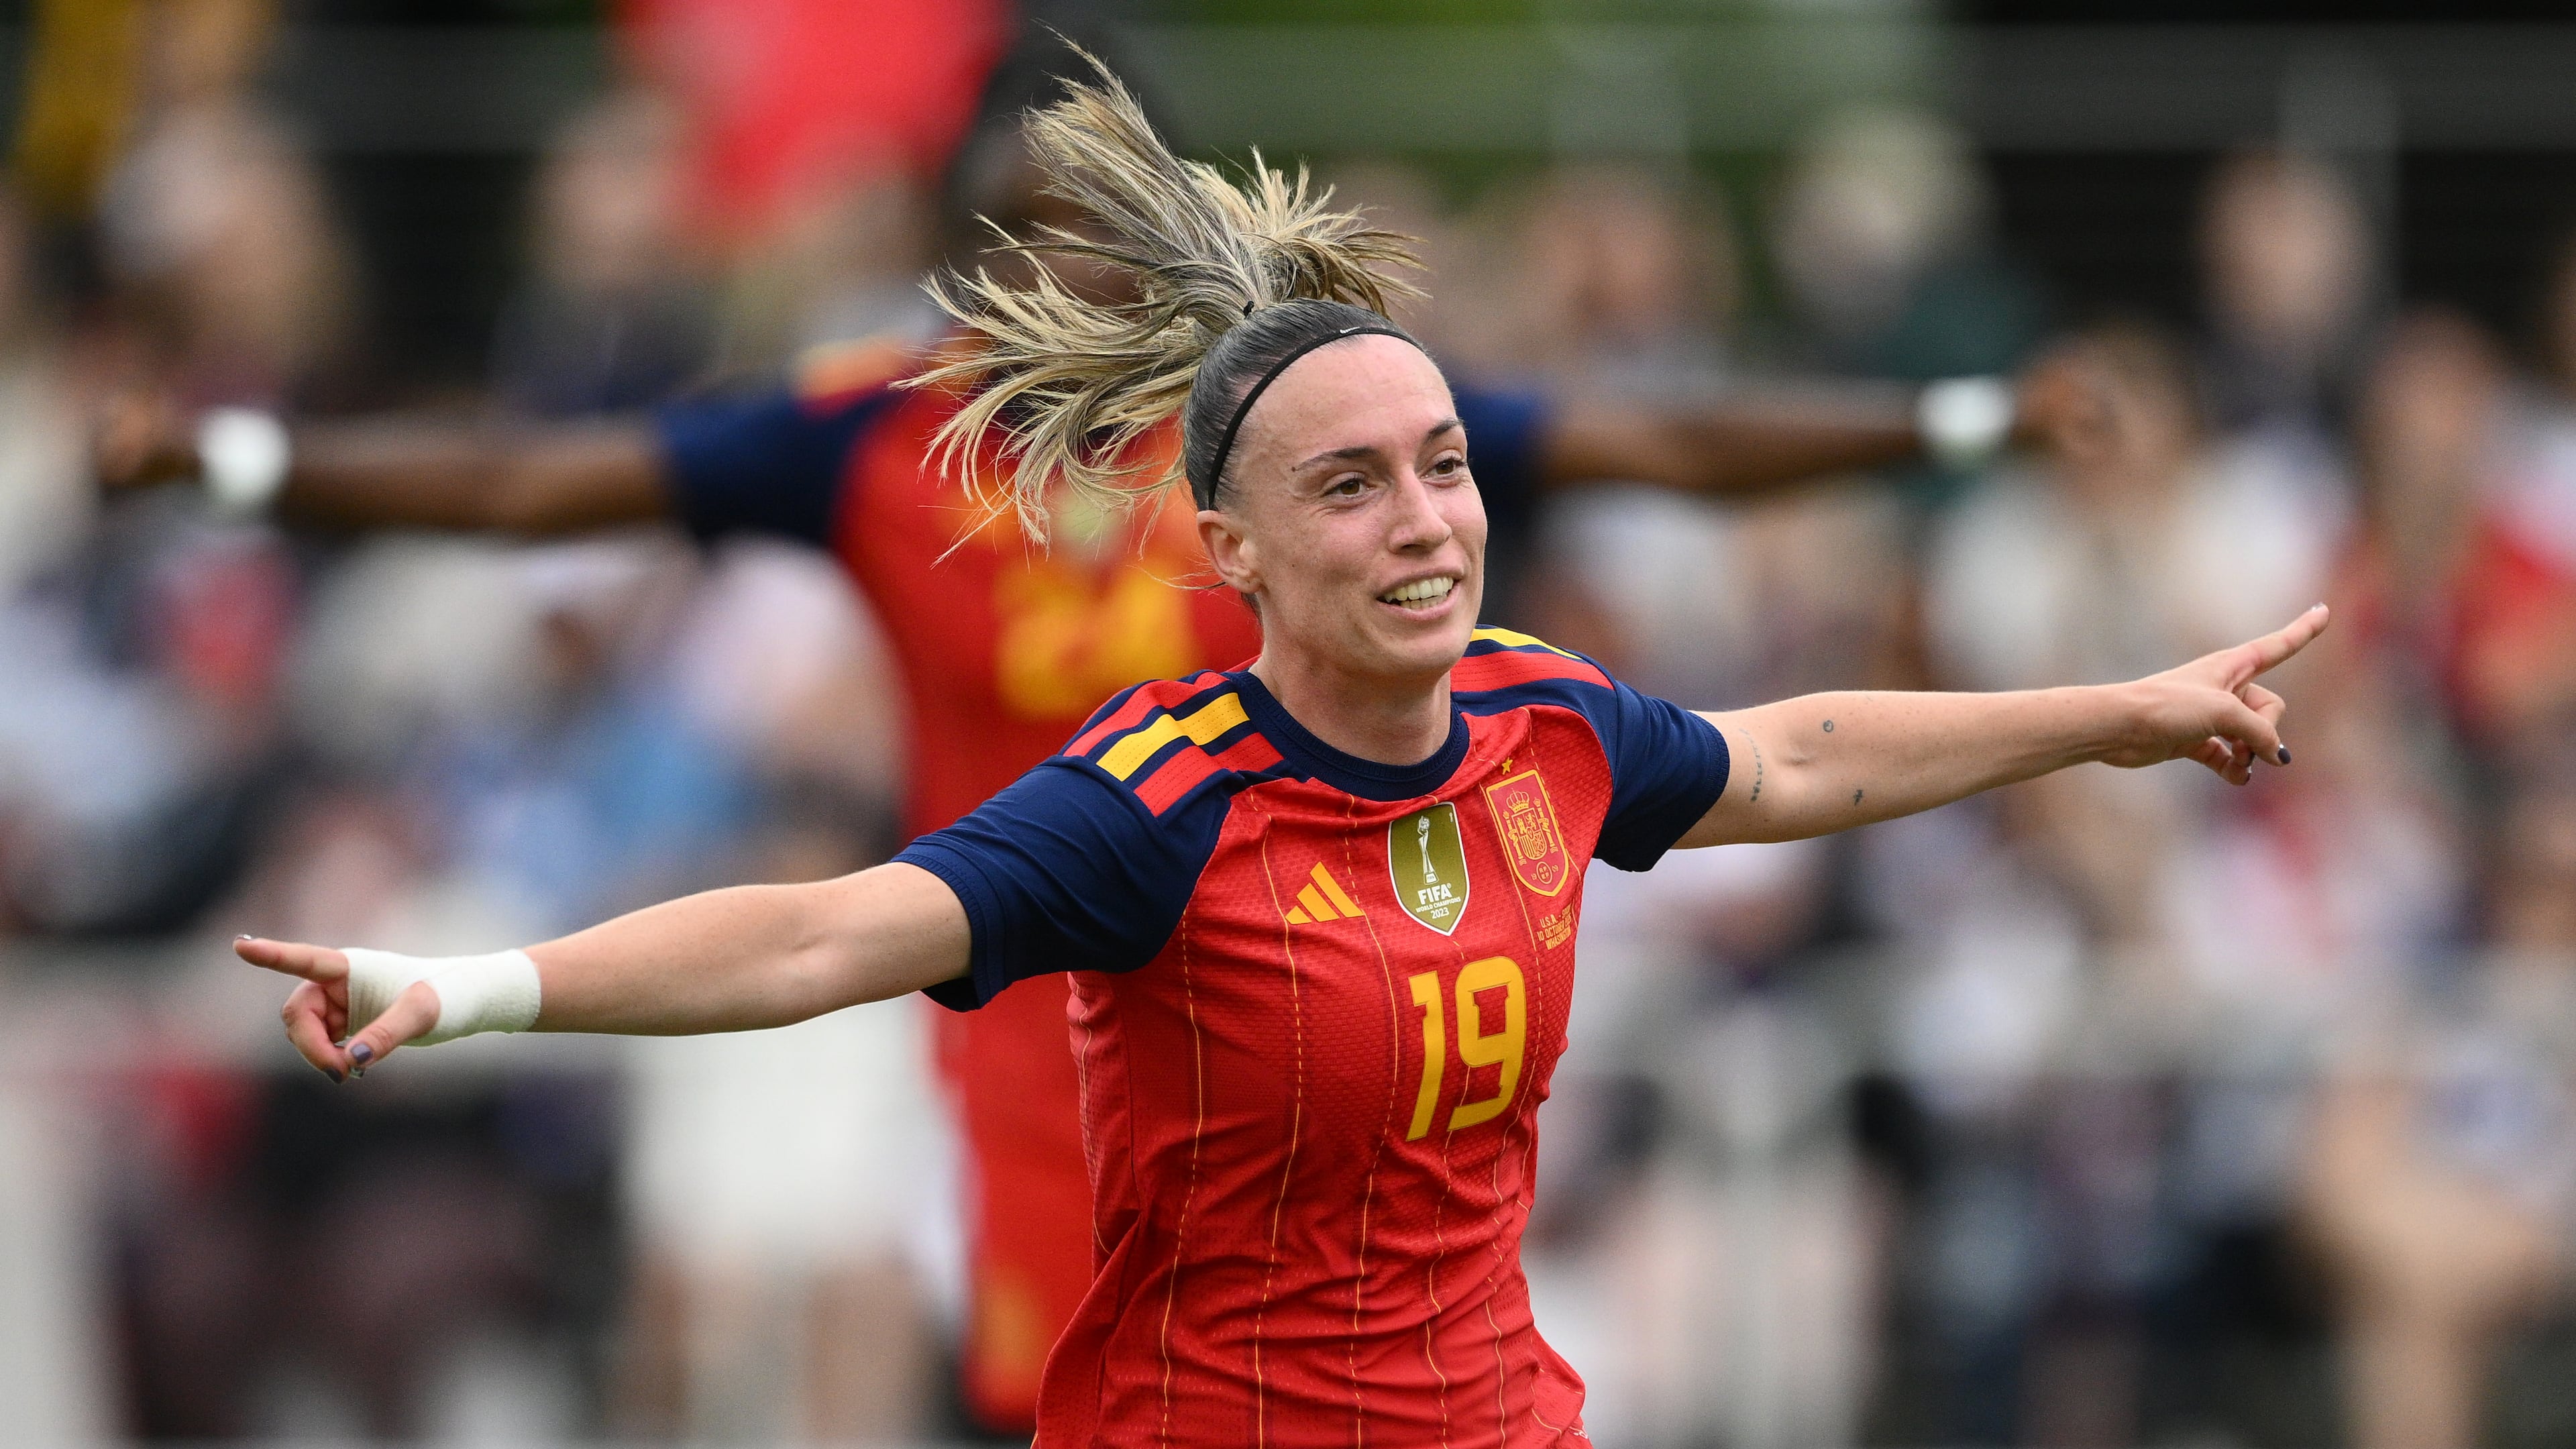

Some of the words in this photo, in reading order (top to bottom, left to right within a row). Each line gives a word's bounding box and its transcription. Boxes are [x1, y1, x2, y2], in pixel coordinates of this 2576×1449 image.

[1415, 904, 1434, 913] WORLD
[1433, 896, 1461, 908] CHAMPIONS
[1430, 907, 1450, 919] 2023
[1537, 930, 1545, 942] 10
[1405, 956, 1527, 1142] 19
